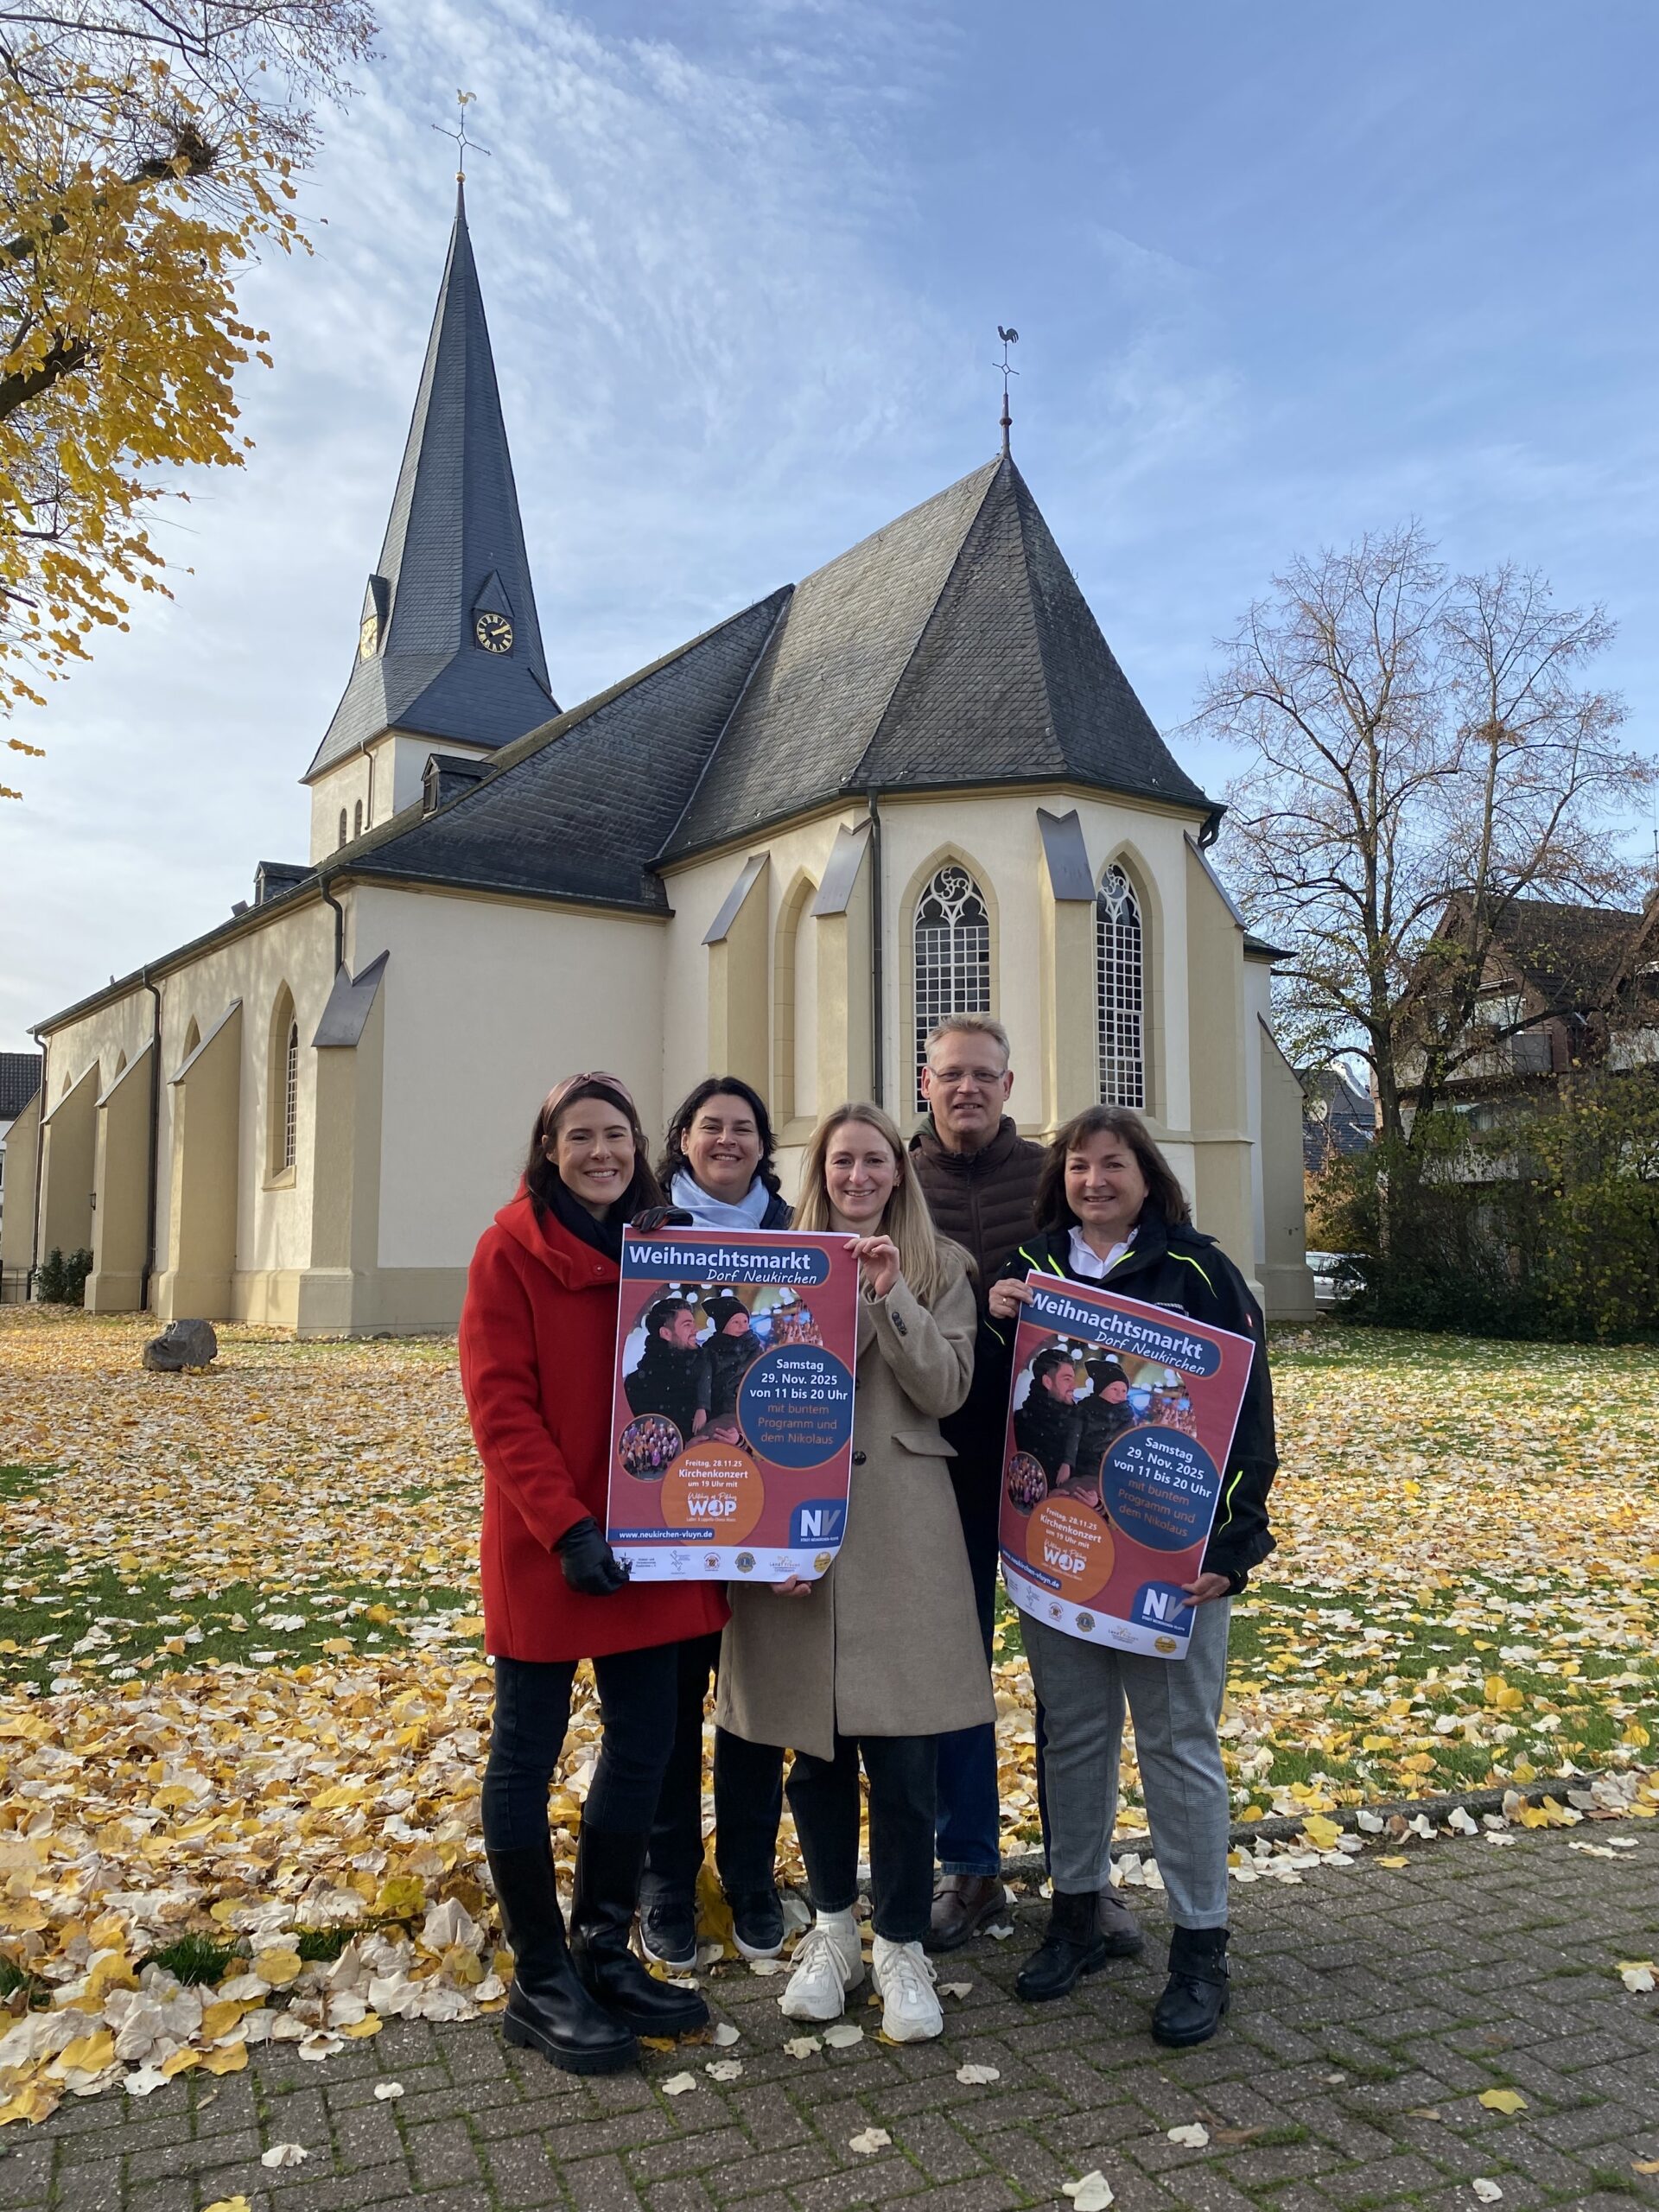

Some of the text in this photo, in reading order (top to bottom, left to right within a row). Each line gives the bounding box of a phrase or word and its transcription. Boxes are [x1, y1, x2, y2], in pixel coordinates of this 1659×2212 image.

[629, 1245, 810, 1270] Weihnachtsmarkt
[706, 1268, 817, 1285] Dorf Neukirchen
[1028, 1293, 1203, 1360] Weihnachtsmarkt
[776, 1358, 824, 1372] Samstag
[1094, 1331, 1205, 1376] Dorf Neukirchen
[761, 1373, 837, 1385] 29. Nov. 2025
[749, 1388, 849, 1401] von 11 bis 20 Uhr
[767, 1403, 830, 1414] mit buntem
[758, 1418, 837, 1431] Programm und
[760, 1432, 834, 1445] dem Nikolaus
[1145, 1437, 1193, 1463] Samstag
[678, 1468, 748, 1478] Kirchenkonzert
[713, 1459, 742, 1468] 28.11.25
[1127, 1446, 1205, 1480] 29. Nov. 2025
[1114, 1459, 1212, 1498] von 11 bis 20 Uhr
[1128, 1479, 1190, 1506] mit buntem
[687, 1499, 737, 1516] WOP
[1118, 1488, 1196, 1523] Programm und
[800, 1510, 842, 1536] NV
[1039, 1514, 1102, 1543] Kirchenkonzert
[1119, 1504, 1188, 1537] dem Nikolaus
[619, 1529, 713, 1540] www.neukirchen-vluyn.de
[1056, 1532, 1064, 1541] 19
[1065, 1535, 1077, 1545] Uhr
[1077, 1541, 1090, 1549] mit
[1044, 1545, 1086, 1573] WOP
[1142, 1588, 1185, 1623] NV
